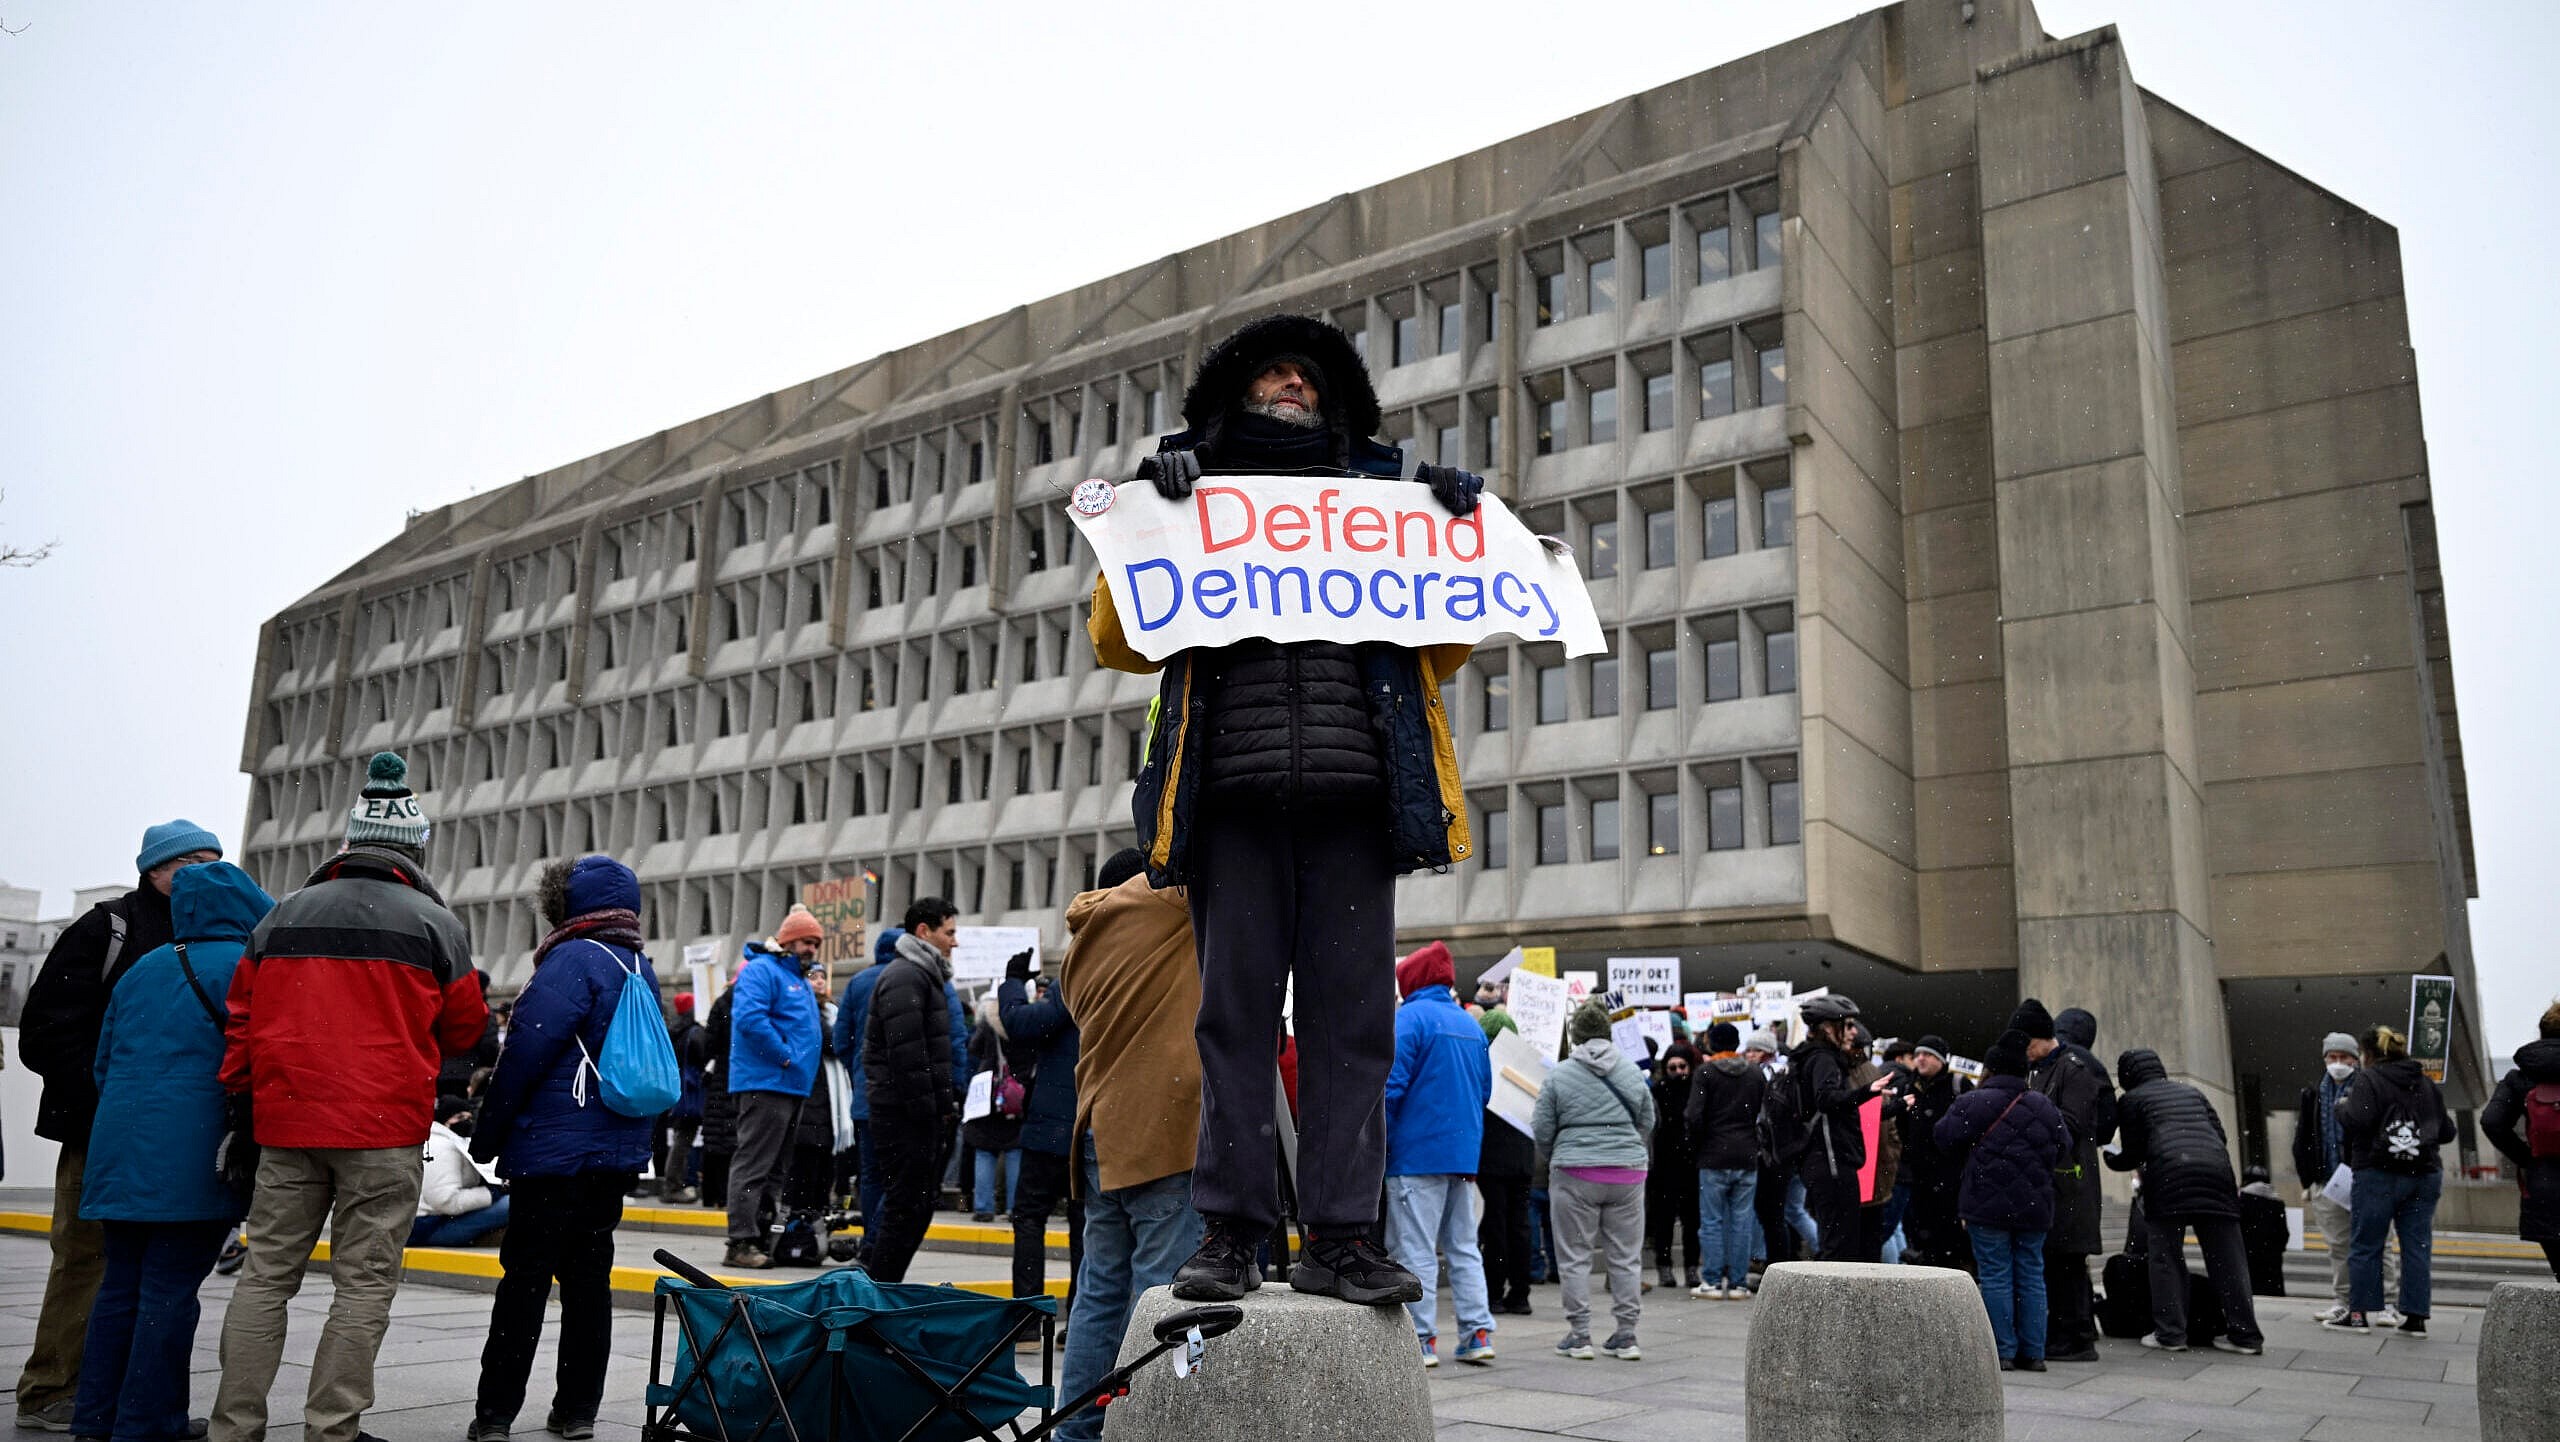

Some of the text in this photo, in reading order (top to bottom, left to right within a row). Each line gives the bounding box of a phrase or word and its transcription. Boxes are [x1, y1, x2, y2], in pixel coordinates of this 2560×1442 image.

[1076, 482, 1098, 496] SAVE
[1195, 487, 1485, 563] Defend
[1125, 558, 1560, 636] Democracy
[816, 930, 865, 962] TURE
[1612, 968, 1670, 980] SUPPORT
[1604, 990, 1625, 1010] AW
[1718, 1001, 1743, 1014] UAW
